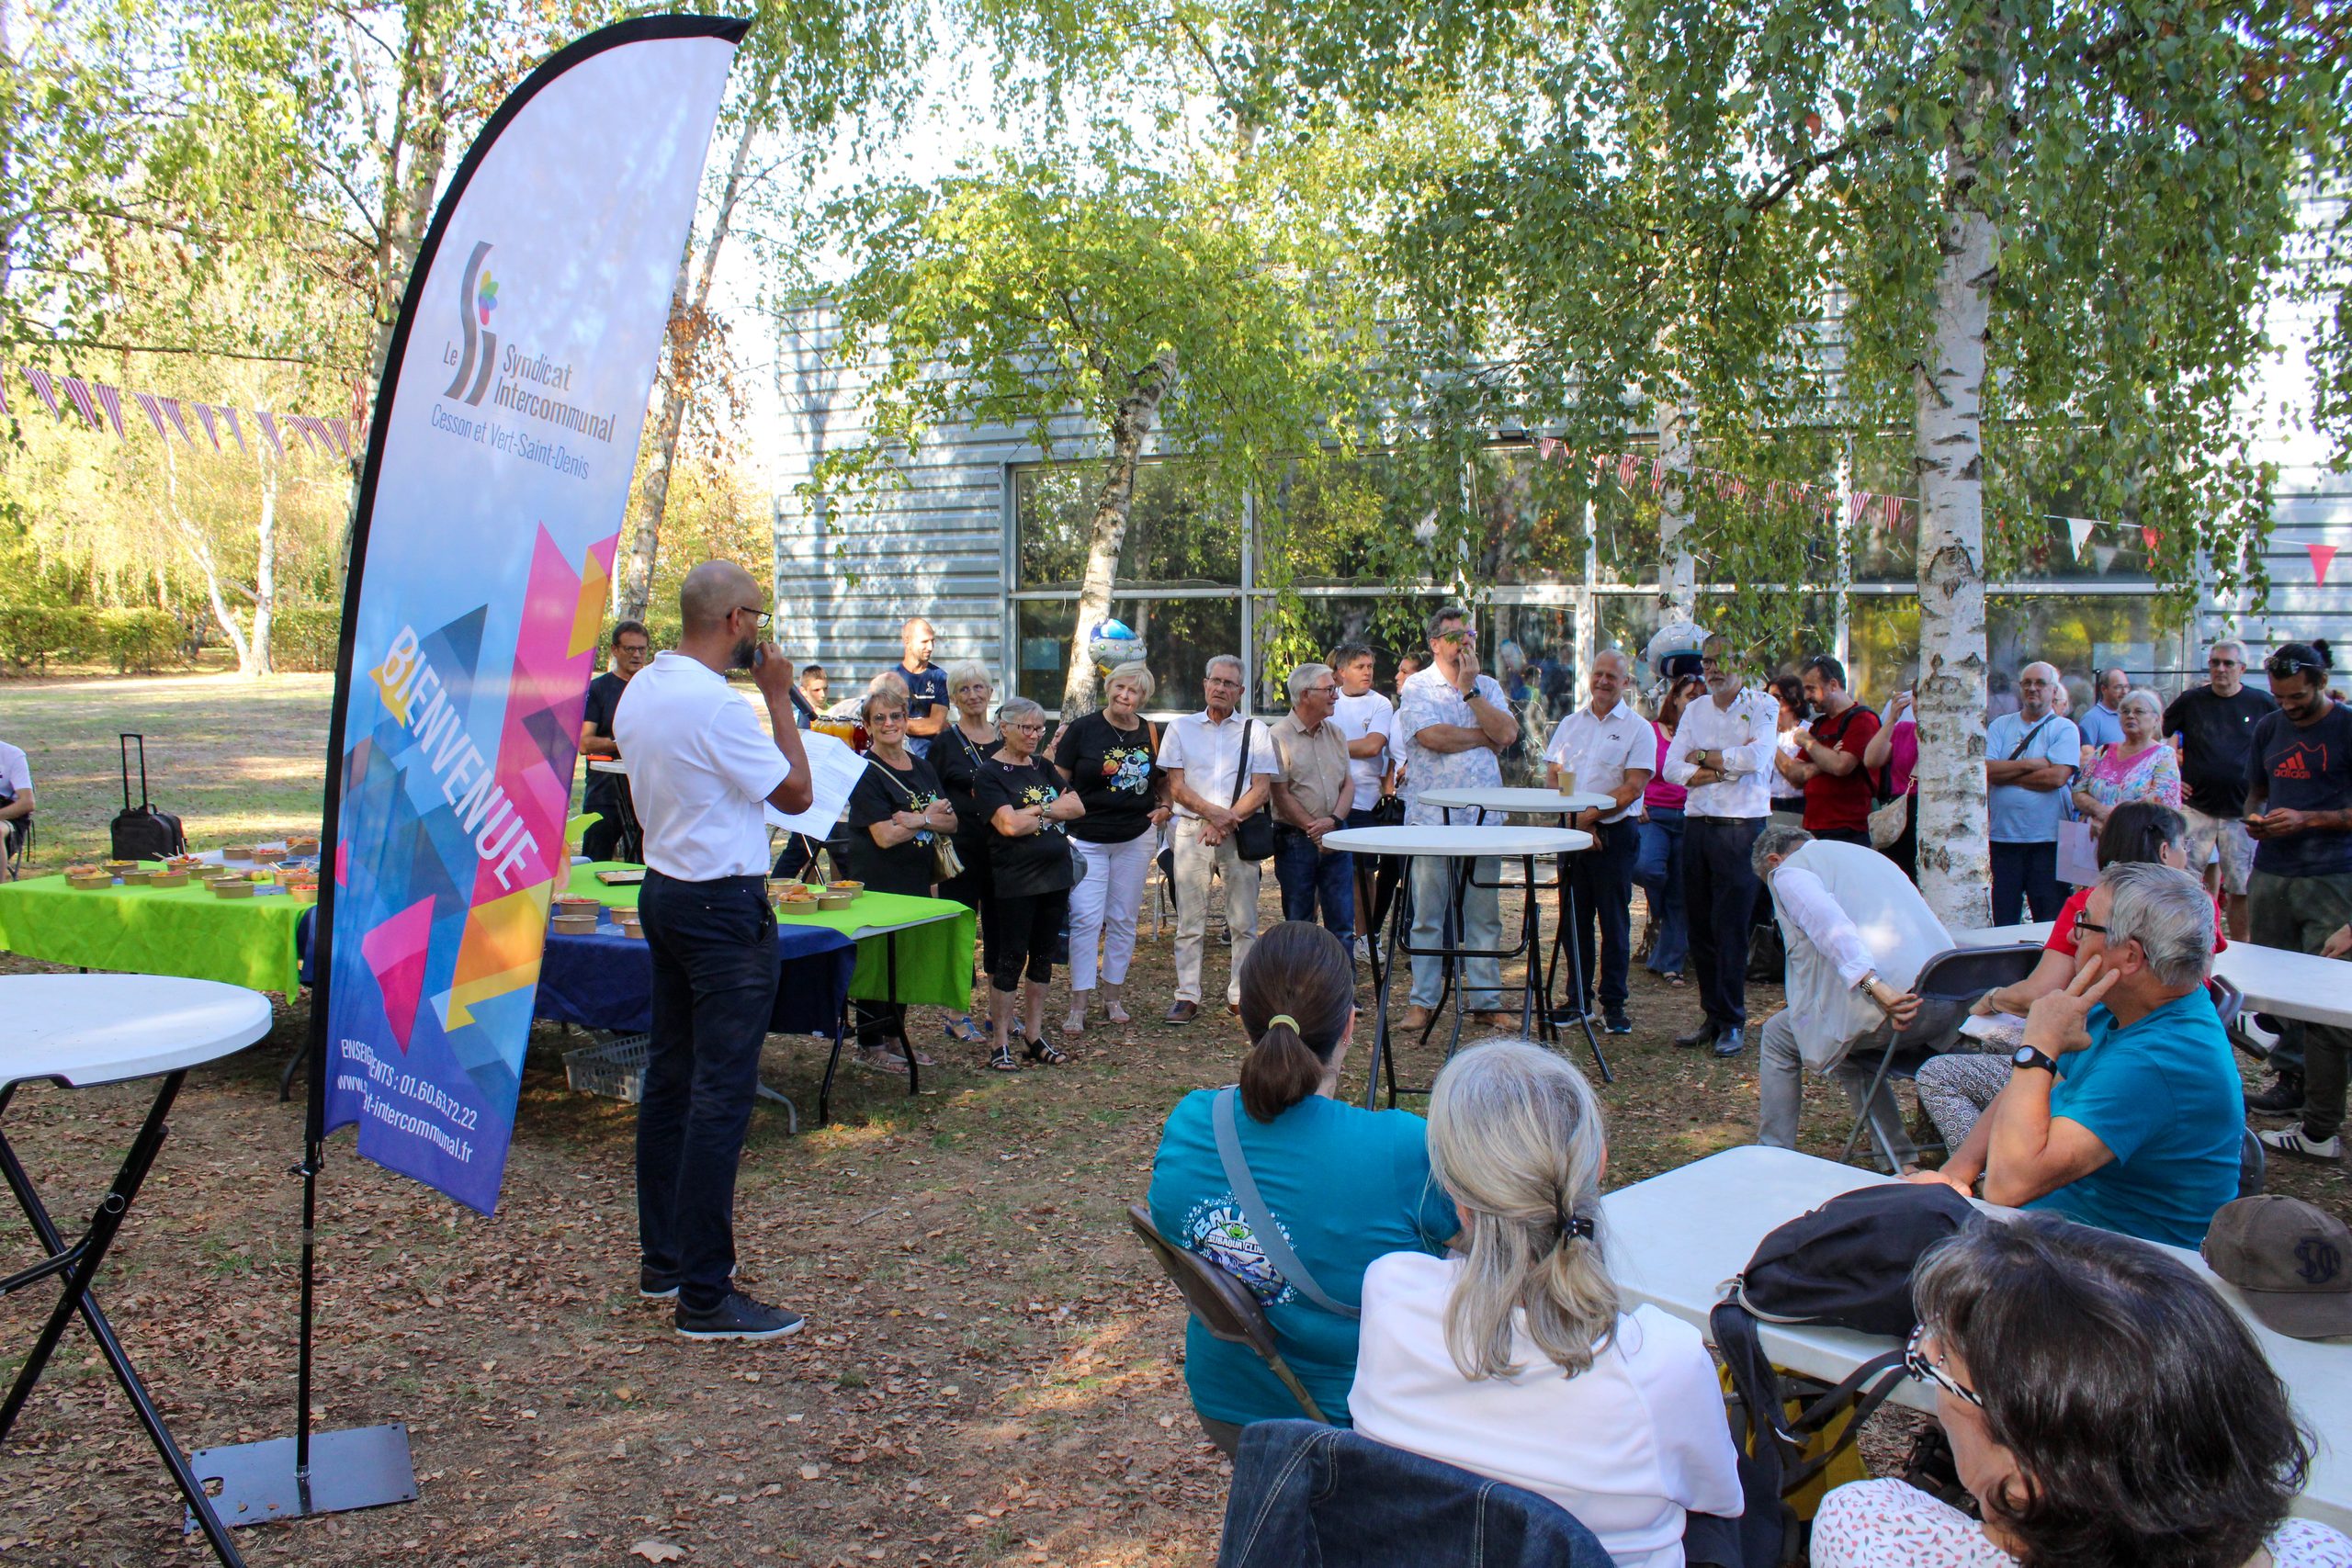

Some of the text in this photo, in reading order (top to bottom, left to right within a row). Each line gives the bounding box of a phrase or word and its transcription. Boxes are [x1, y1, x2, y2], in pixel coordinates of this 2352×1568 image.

[443, 341, 458, 367] Le
[503, 344, 572, 391] Syndicat
[493, 377, 616, 443] Intercommunal
[431, 403, 590, 479] Cesson et Vert-Saint-Denis
[381, 624, 539, 891] BIENVENUE
[400, 1075, 478, 1131] 01.60.63.72.22
[1207, 1235, 1244, 1250] SUBAQUA
